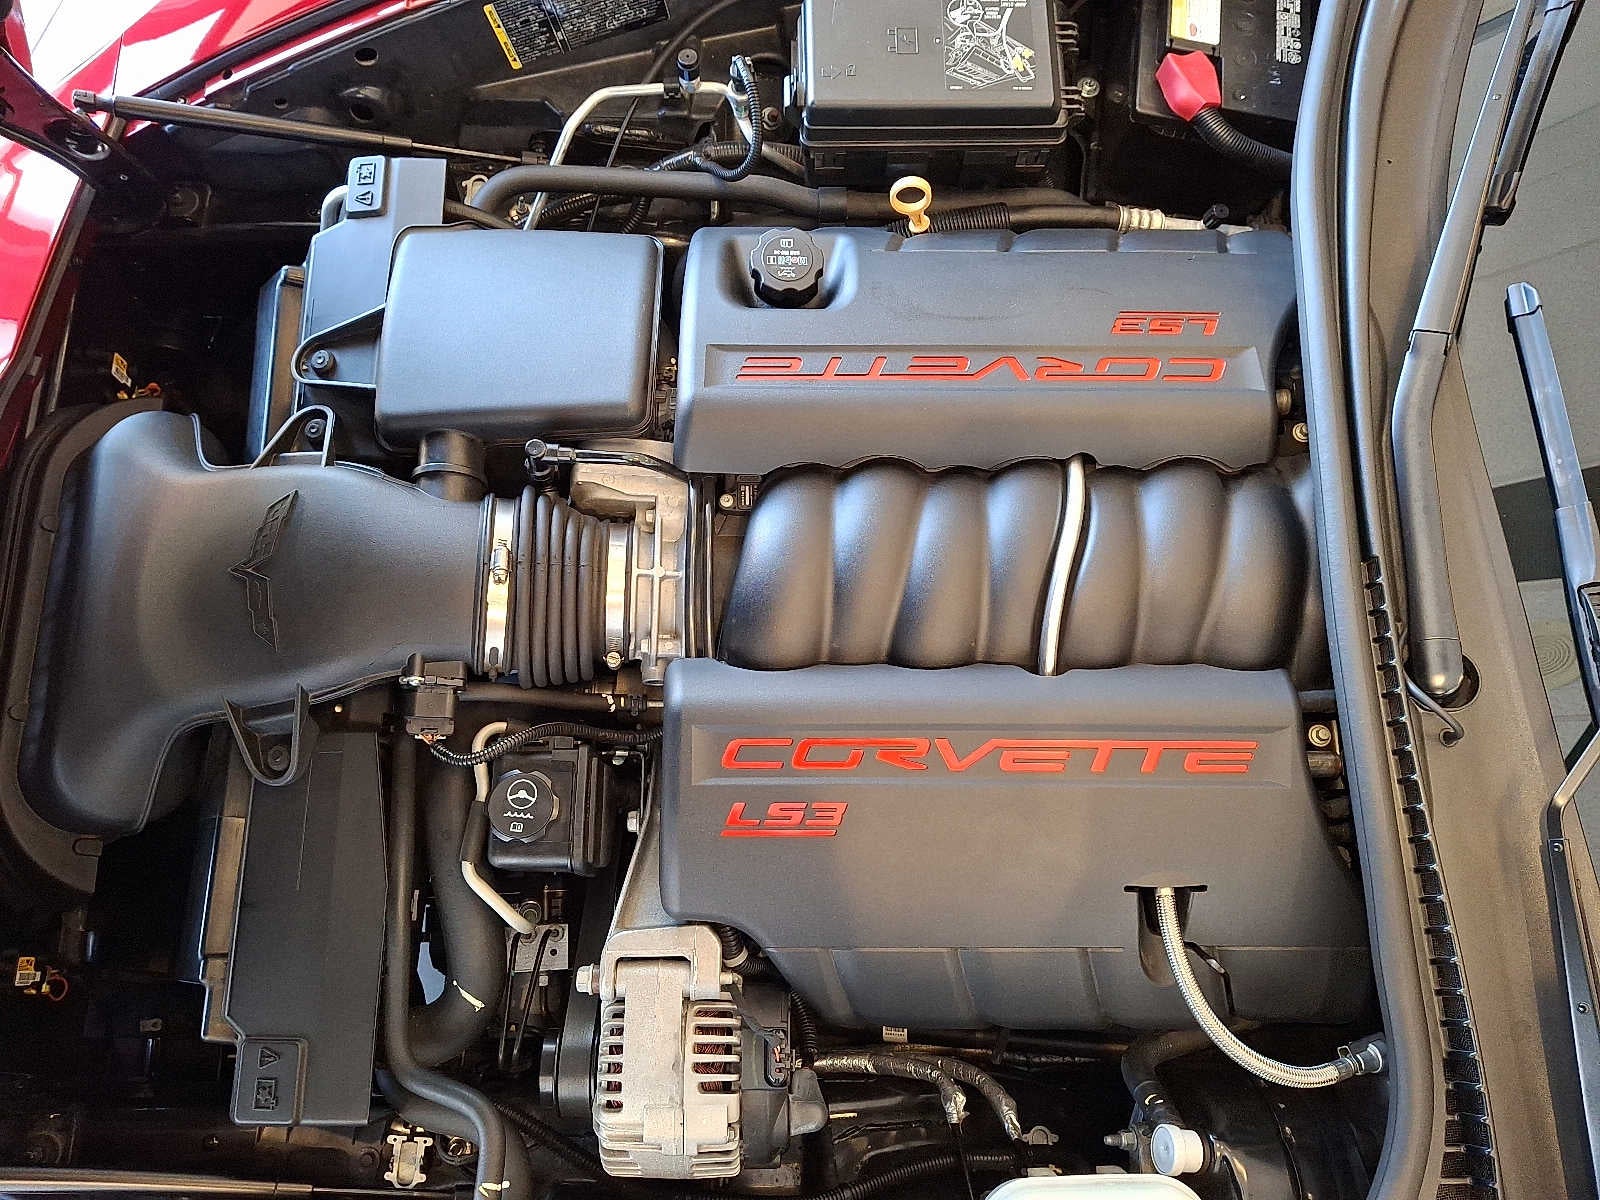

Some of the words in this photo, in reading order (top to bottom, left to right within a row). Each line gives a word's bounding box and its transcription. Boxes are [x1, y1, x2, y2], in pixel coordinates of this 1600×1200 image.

[778, 256, 808, 266] Mobil
[1110, 317, 1219, 336] LS3
[735, 356, 1227, 382] CORVETTE
[721, 738, 1259, 774] CORVETTE
[724, 802, 848, 828] LS3
